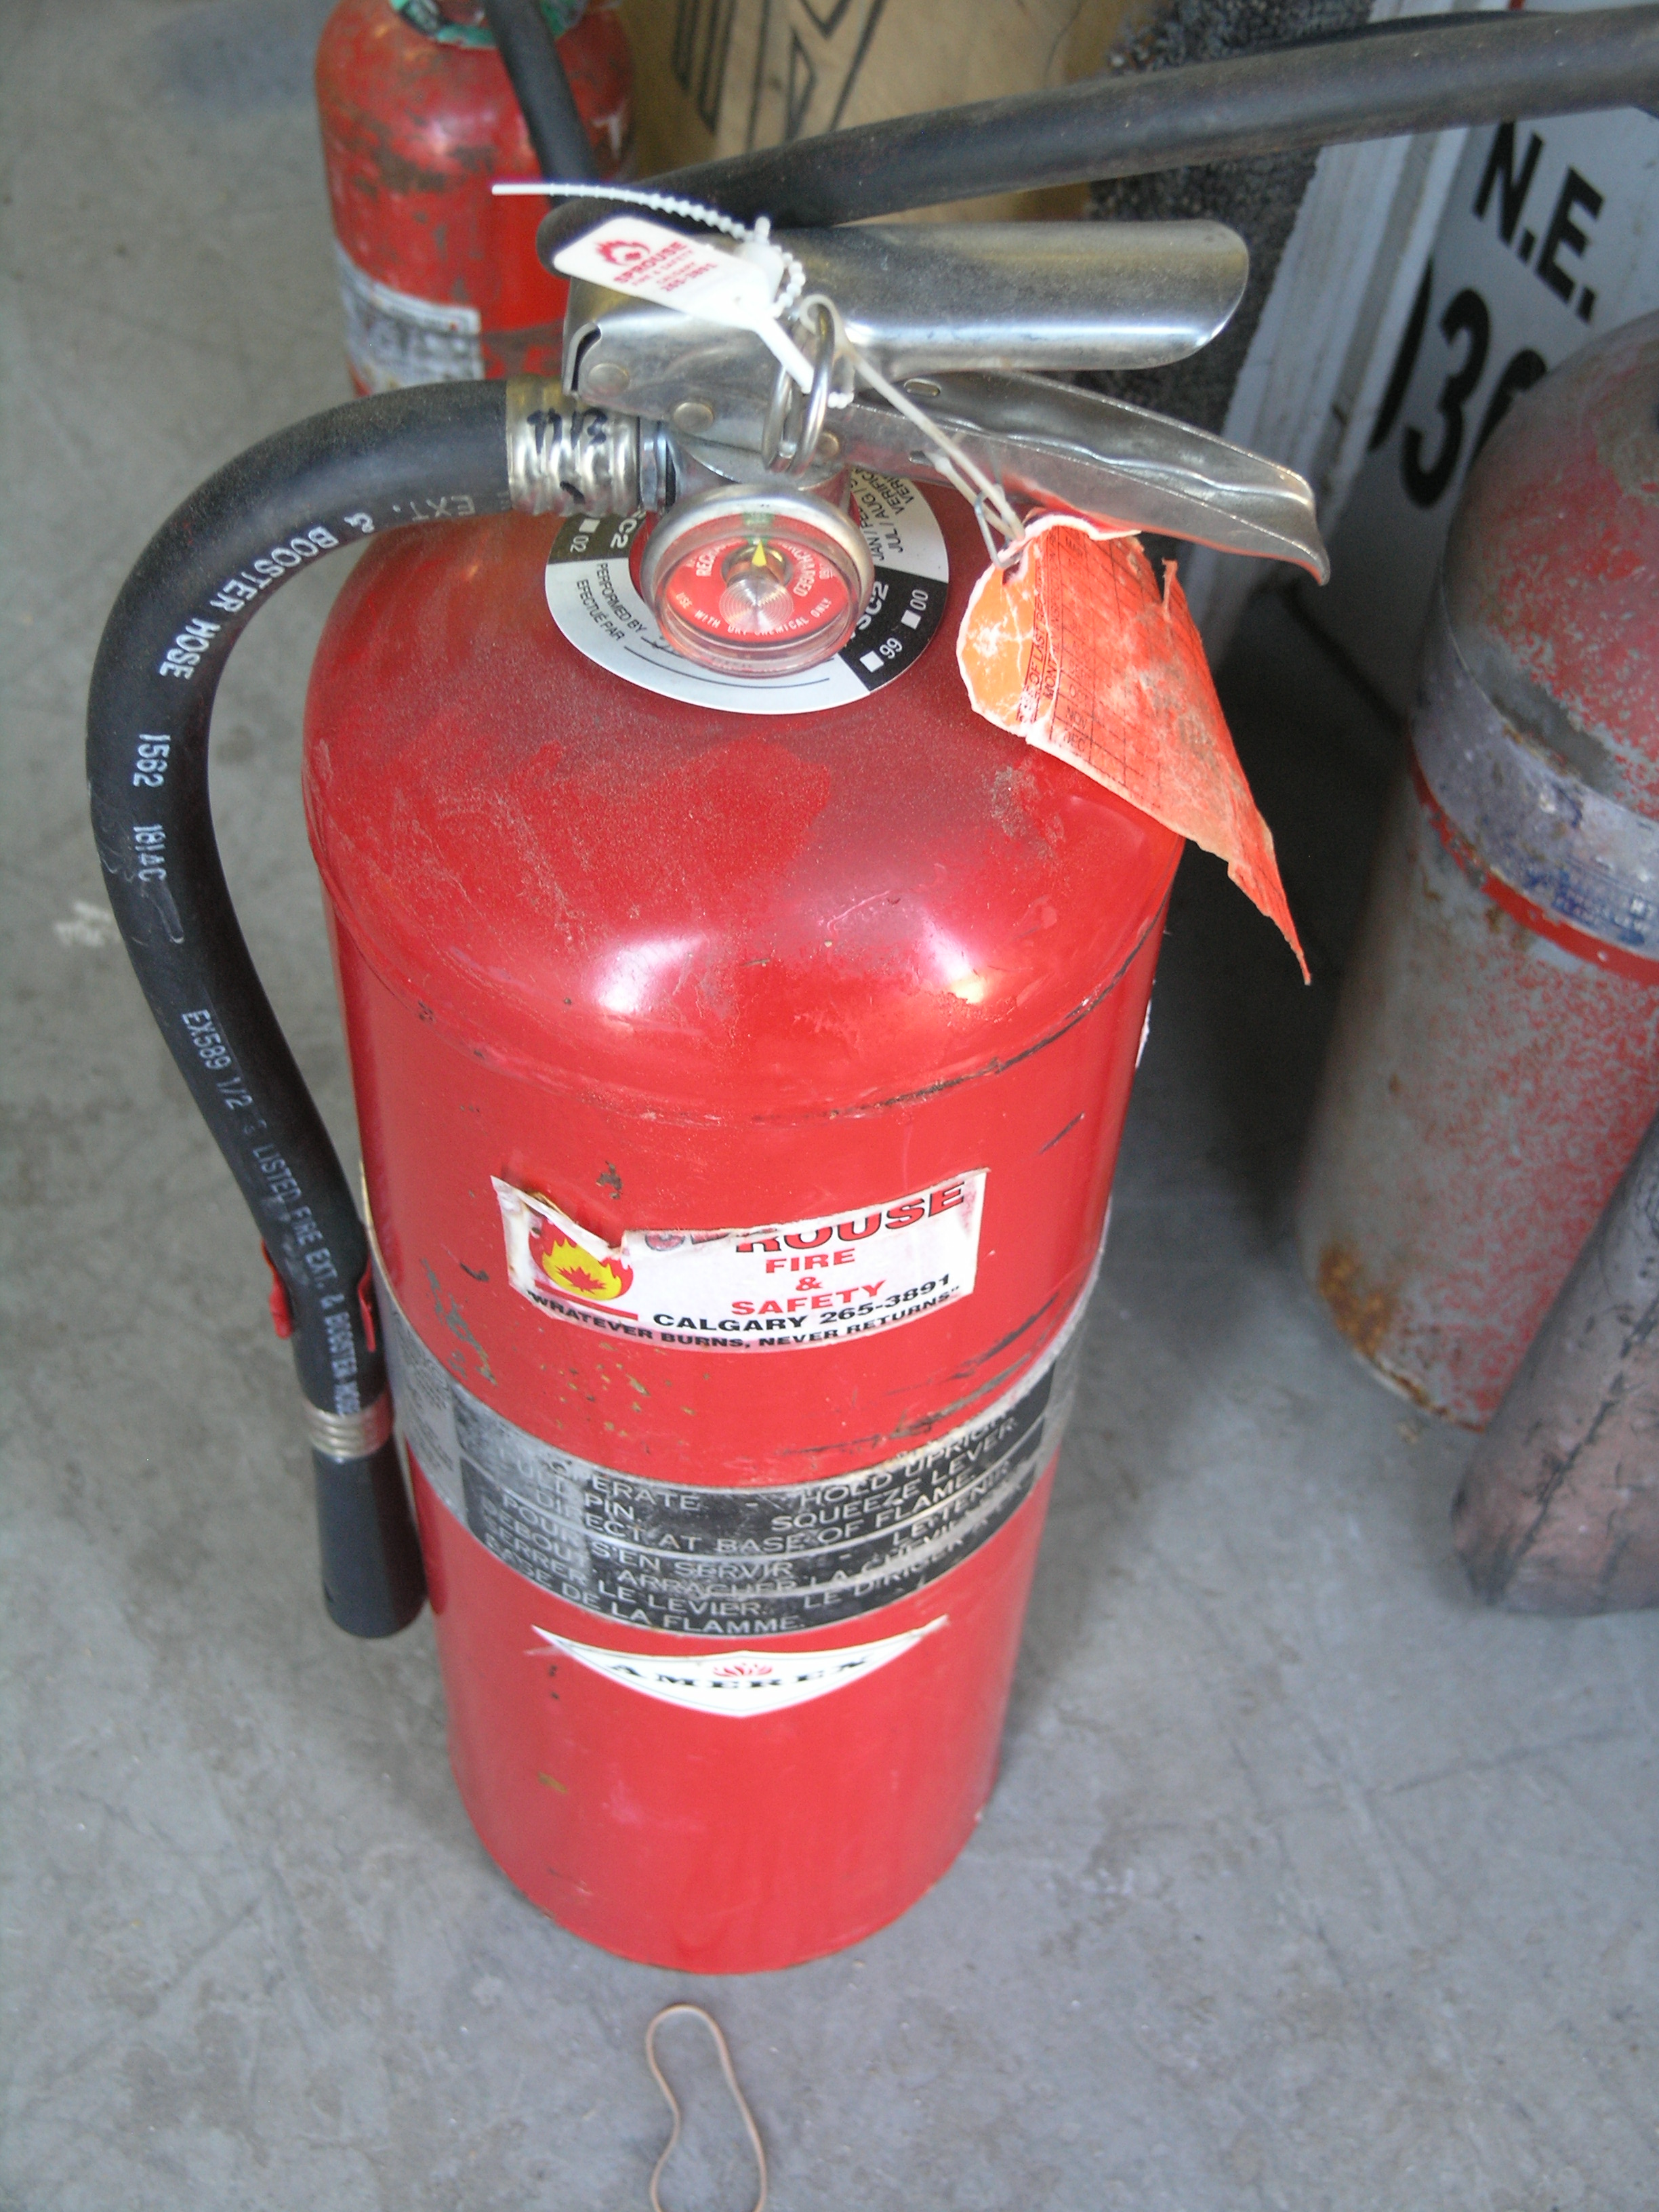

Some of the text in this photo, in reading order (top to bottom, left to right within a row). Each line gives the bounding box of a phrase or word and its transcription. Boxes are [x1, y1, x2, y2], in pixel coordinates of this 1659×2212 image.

[861, 493, 890, 519] AUG
[570, 535, 590, 554] 02
[867, 537, 884, 561] JAN
[885, 528, 903, 553] JUL
[209, 526, 340, 613] BOOSTER
[596, 562, 647, 634] PERFORMED BY
[676, 592, 693, 609] USE
[694, 609, 721, 629] WITH
[909, 589, 928, 611] 00
[159, 618, 222, 680] HOSE
[600, 621, 625, 641] PAR
[879, 638, 903, 659] 99
[1033, 623, 1045, 660] LAST
[1029, 659, 1043, 685] OF
[133, 733, 171, 787] 1562
[182, 1009, 252, 1111] EX589 1/2
[252, 1144, 302, 1204] LISTED
[290, 1205, 324, 1246] FIRE
[765, 1248, 856, 1274] FIRE
[731, 1279, 886, 1316] SAFETY
[795, 1276, 823, 1292] &
[653, 1273, 951, 1332] CALGARY 265-3891
[661, 1332, 750, 1348] BURNS,
[758, 1328, 838, 1347] NEVER
[771, 1478, 920, 1532] SQUEEZE
[931, 1416, 1016, 1486] LEVER
[800, 1471, 893, 1507] HOLD
[503, 1494, 581, 1548] POUR
[592, 1540, 660, 1571] S'EN
[674, 1561, 796, 1580] SERVIR
[537, 1490, 647, 1542] DIRECT
[659, 1533, 702, 1552] AT
[716, 1534, 805, 1553] BASE
[817, 1519, 865, 1544] OF
[562, 1582, 601, 1610] DE
[613, 1602, 653, 1626] LA
[598, 1579, 636, 1604] LE
[804, 1591, 842, 1609] LE
[611, 1654, 872, 1689] AMEREX
